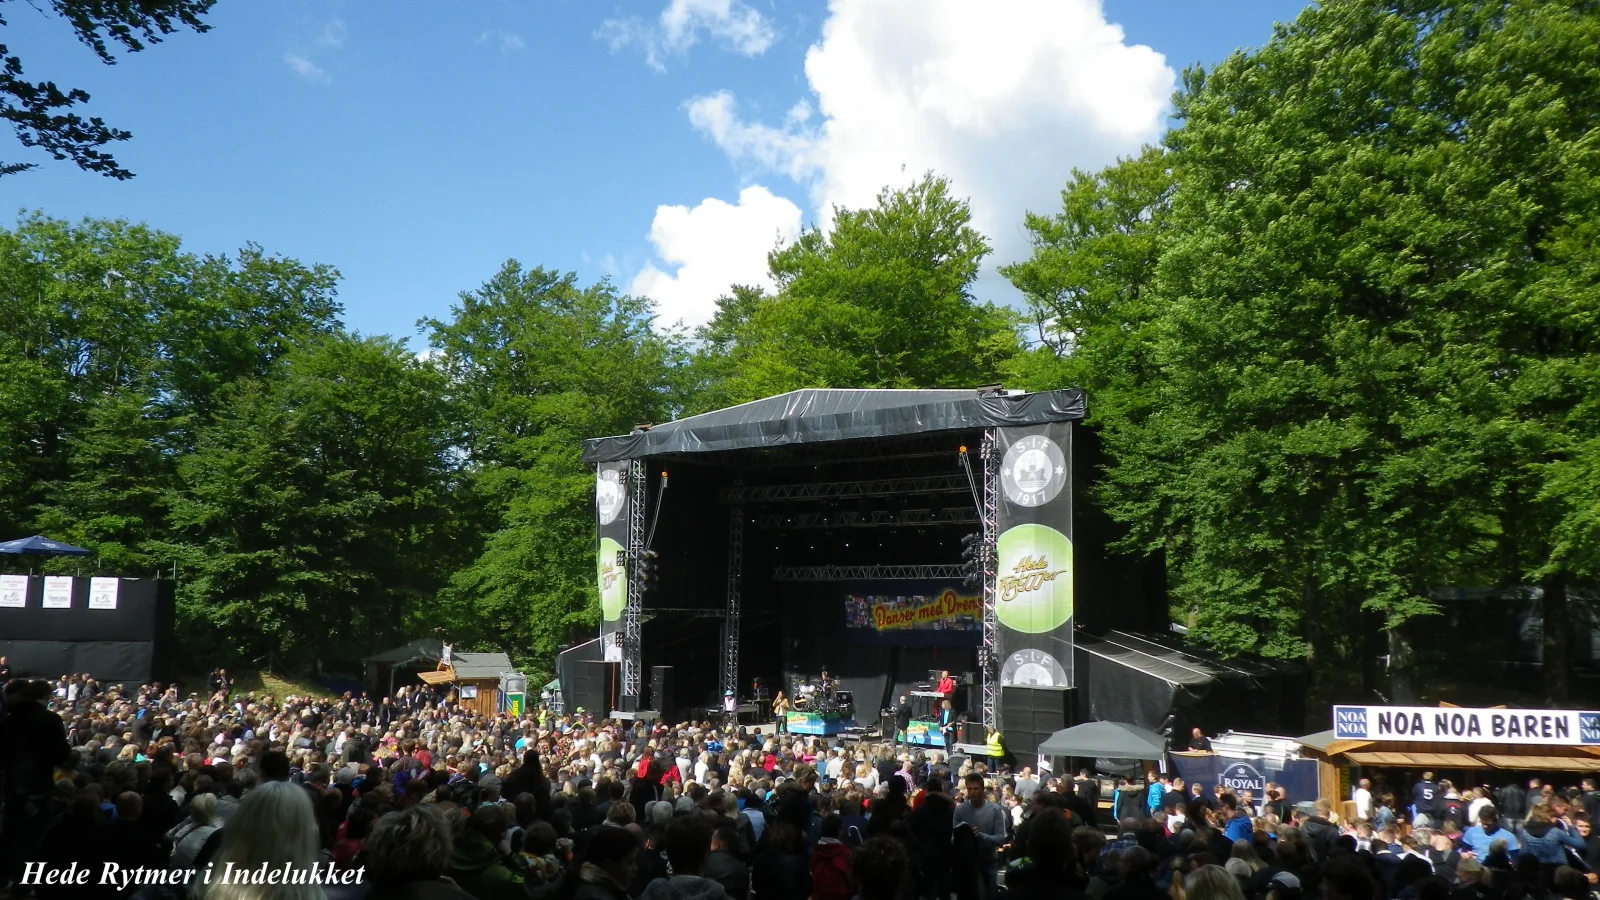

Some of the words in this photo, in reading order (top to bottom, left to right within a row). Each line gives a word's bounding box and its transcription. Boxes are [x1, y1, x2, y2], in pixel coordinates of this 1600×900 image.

[1015, 490, 1047, 505] 1917
[874, 604, 916, 629] Danser
[918, 602, 943, 619] med
[1337, 711, 1367, 723] NOA
[1338, 722, 1368, 734] NOA
[1378, 711, 1425, 736] NOA
[1434, 712, 1482, 738] NOA
[1491, 714, 1570, 739] BAREN
[1581, 728, 1600, 740] NO
[1224, 777, 1263, 790] ROYAL
[1423, 788, 1433, 800] 5
